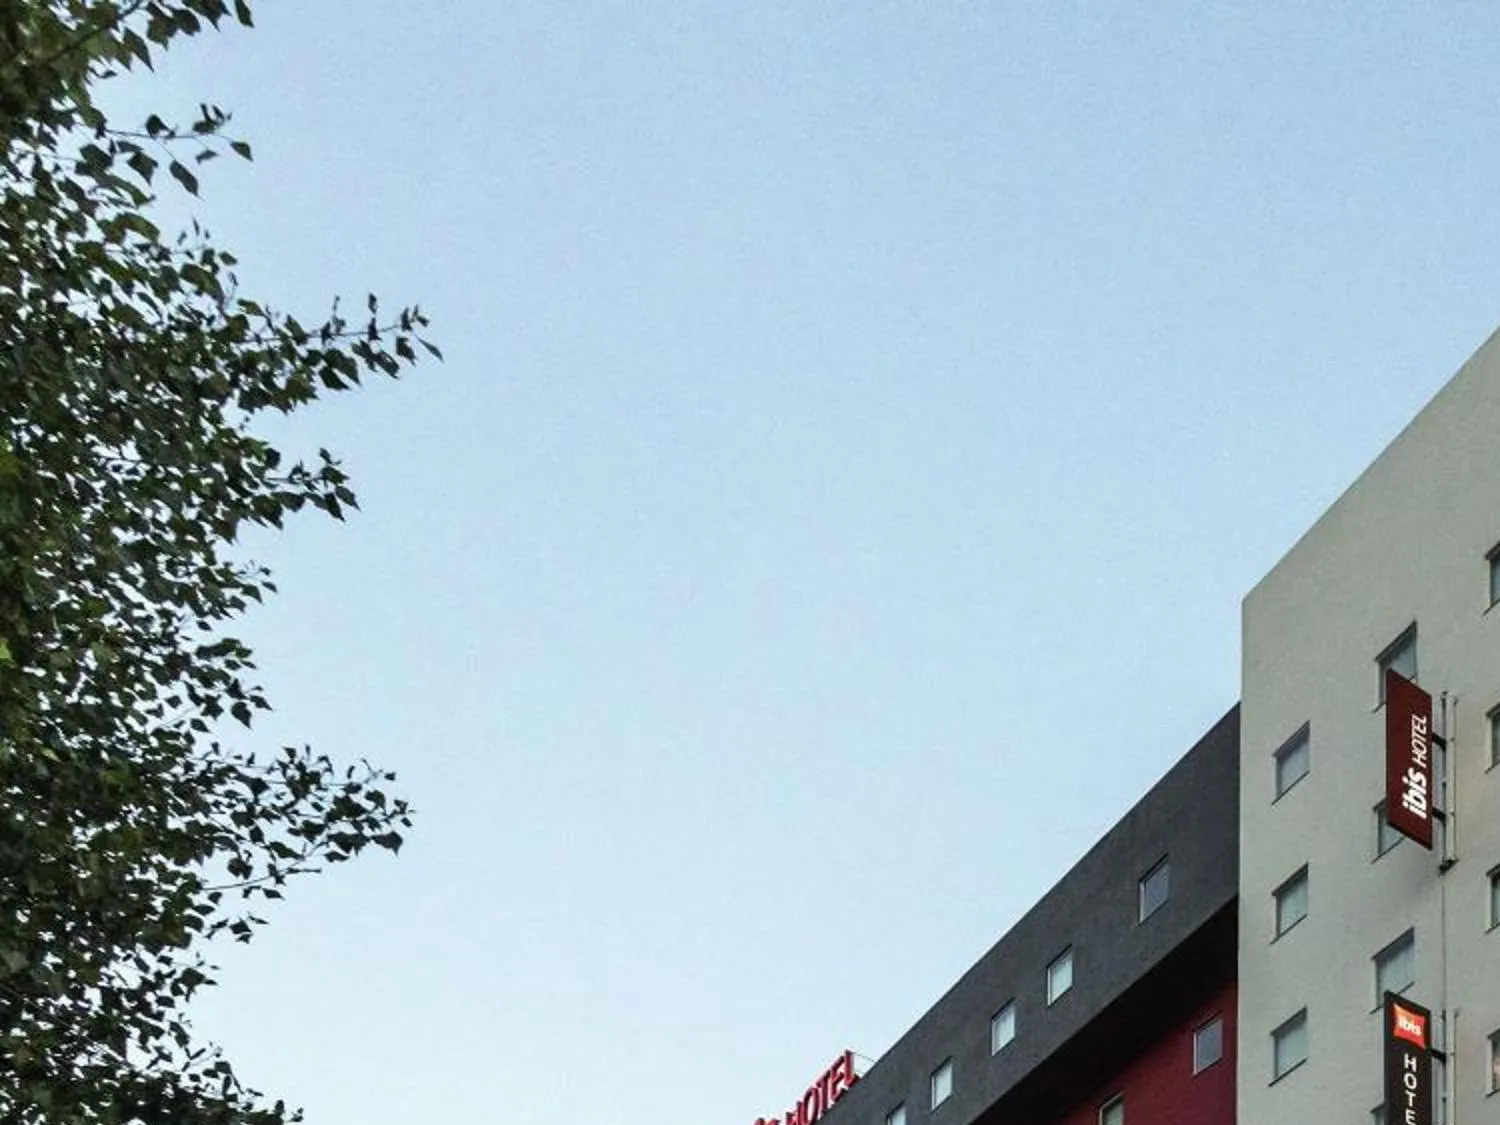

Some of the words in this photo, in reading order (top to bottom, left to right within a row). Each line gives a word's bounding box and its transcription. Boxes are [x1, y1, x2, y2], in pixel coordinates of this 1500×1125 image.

[1411, 714, 1427, 768] HOTEL
[1402, 767, 1427, 819] ibis
[1397, 1016, 1422, 1036] ibis
